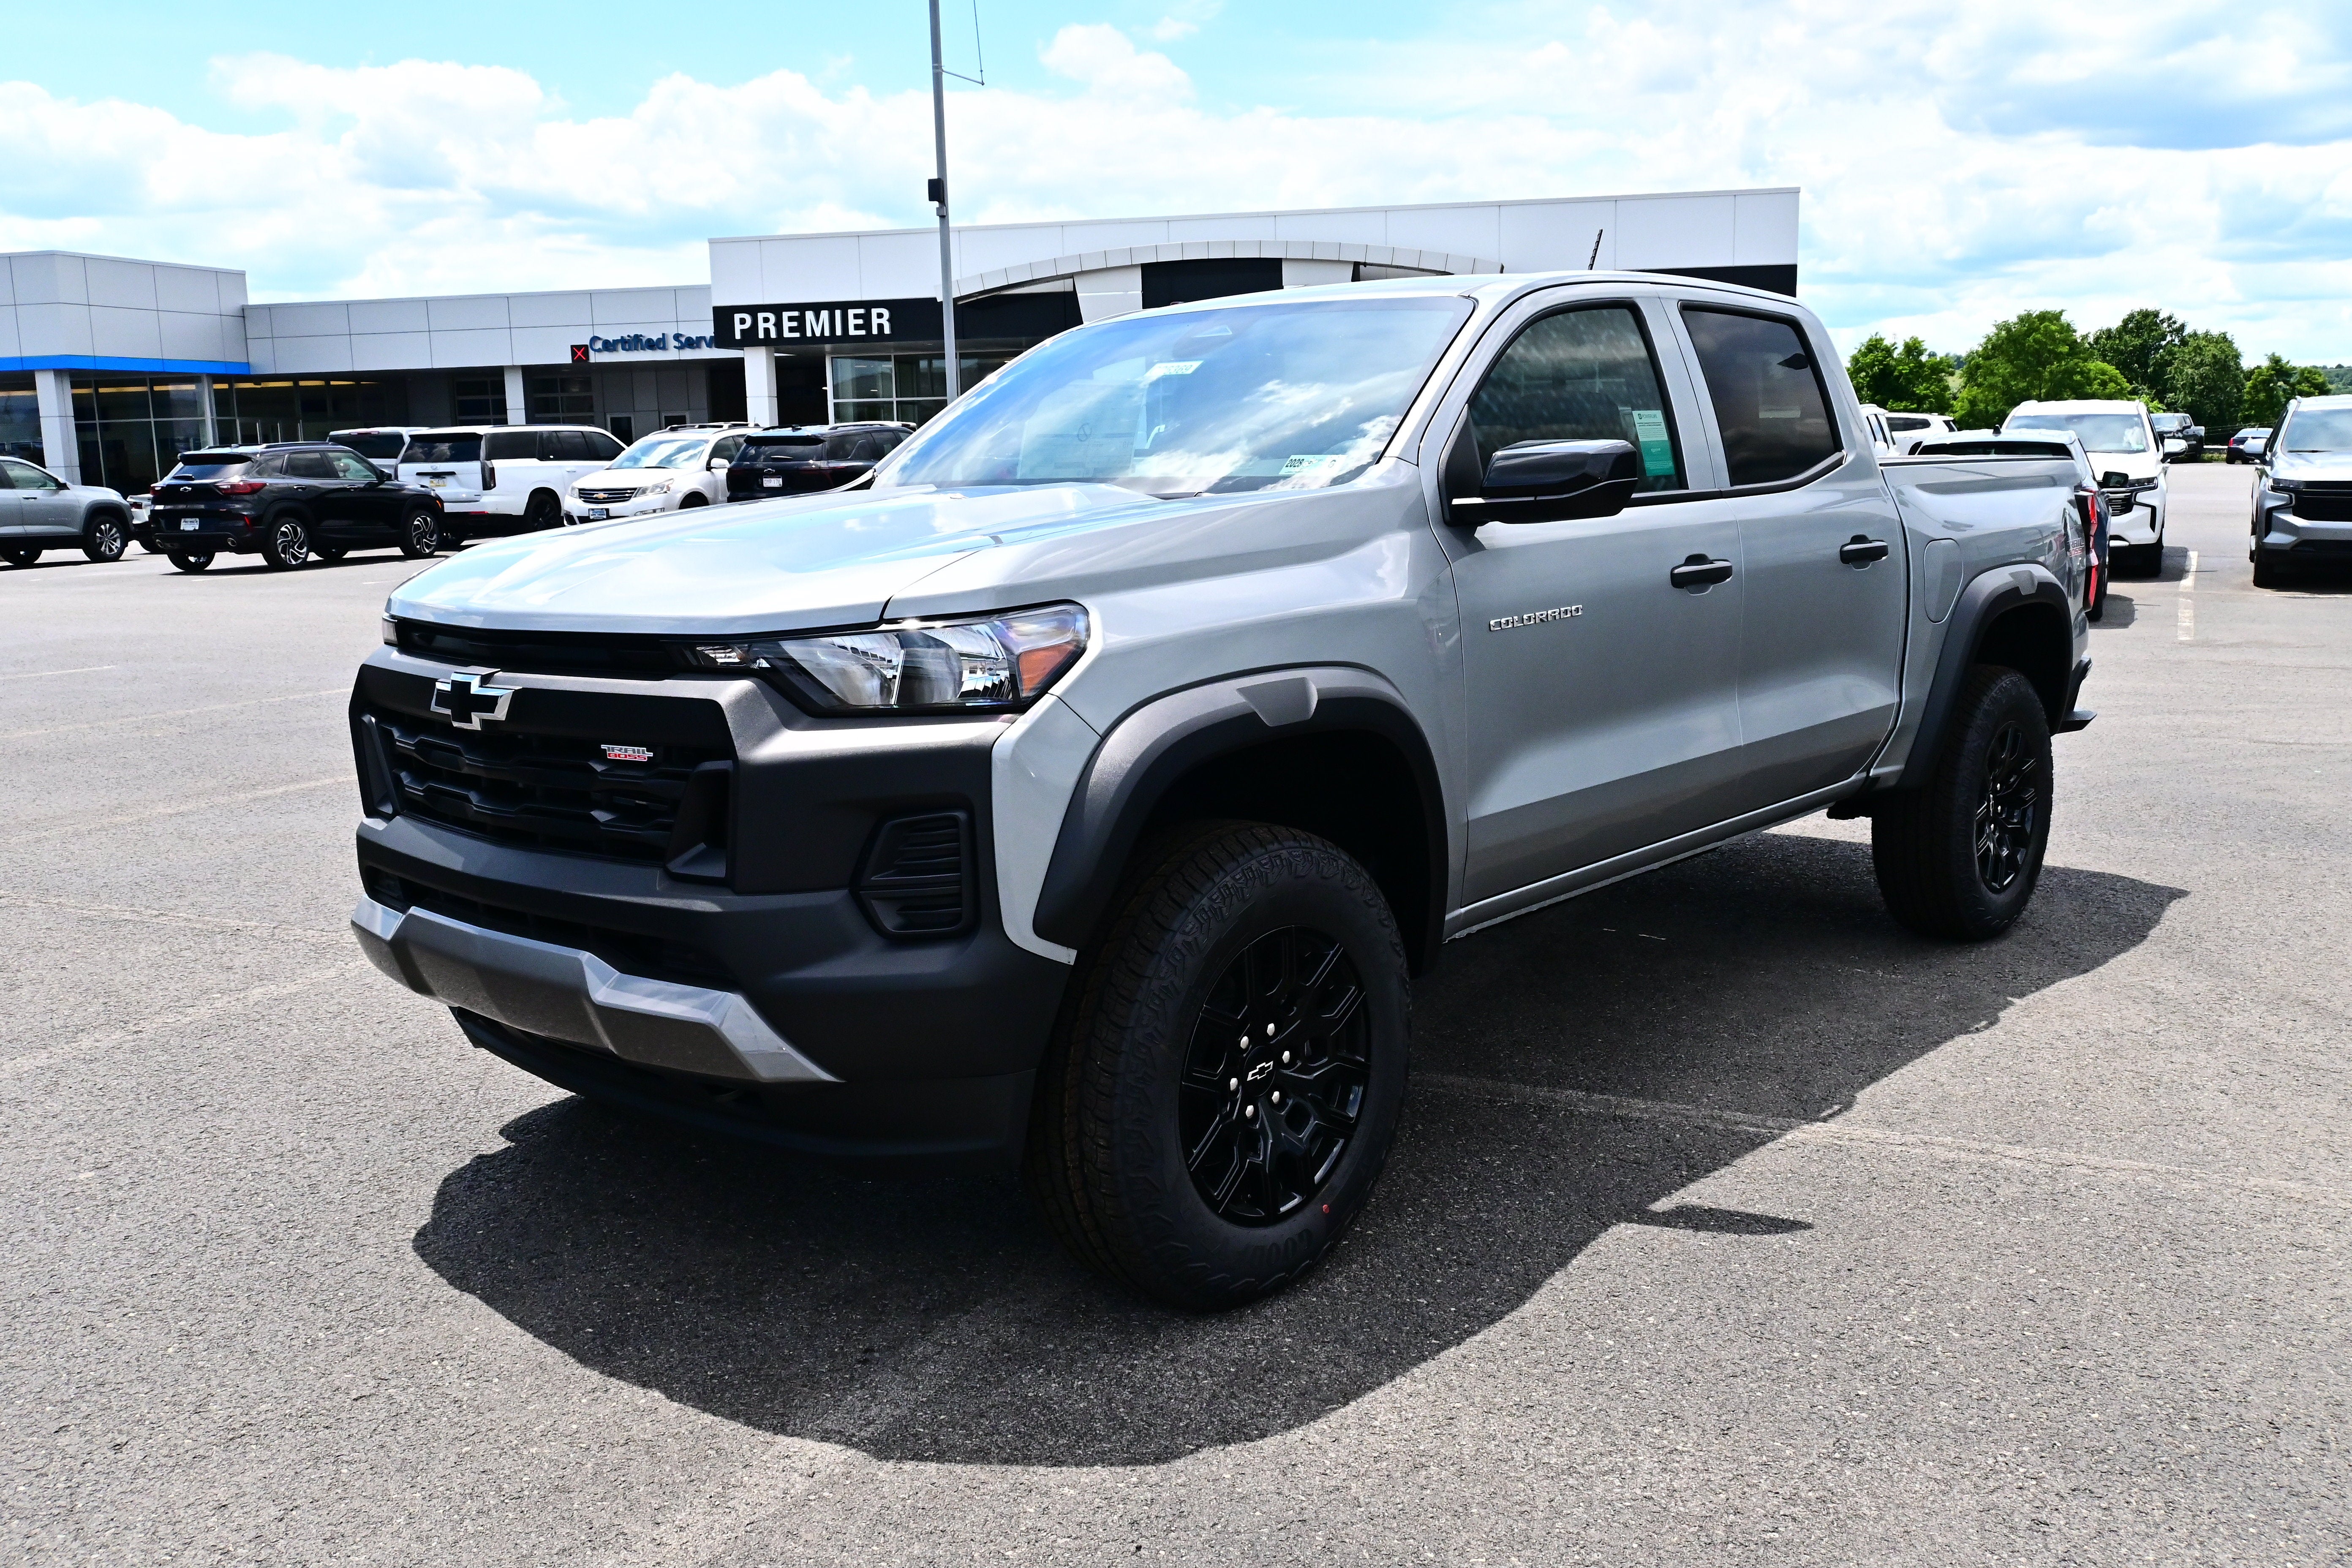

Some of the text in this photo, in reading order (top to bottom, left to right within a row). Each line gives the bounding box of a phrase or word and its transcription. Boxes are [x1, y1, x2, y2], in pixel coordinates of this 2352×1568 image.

[734, 308, 891, 339] PREMIER
[589, 333, 667, 352] Certified
[1285, 458, 1304, 468] 2028
[1489, 604, 1583, 631] COLORADO
[601, 745, 653, 756] TRAIL
[607, 752, 648, 761] BOSS
